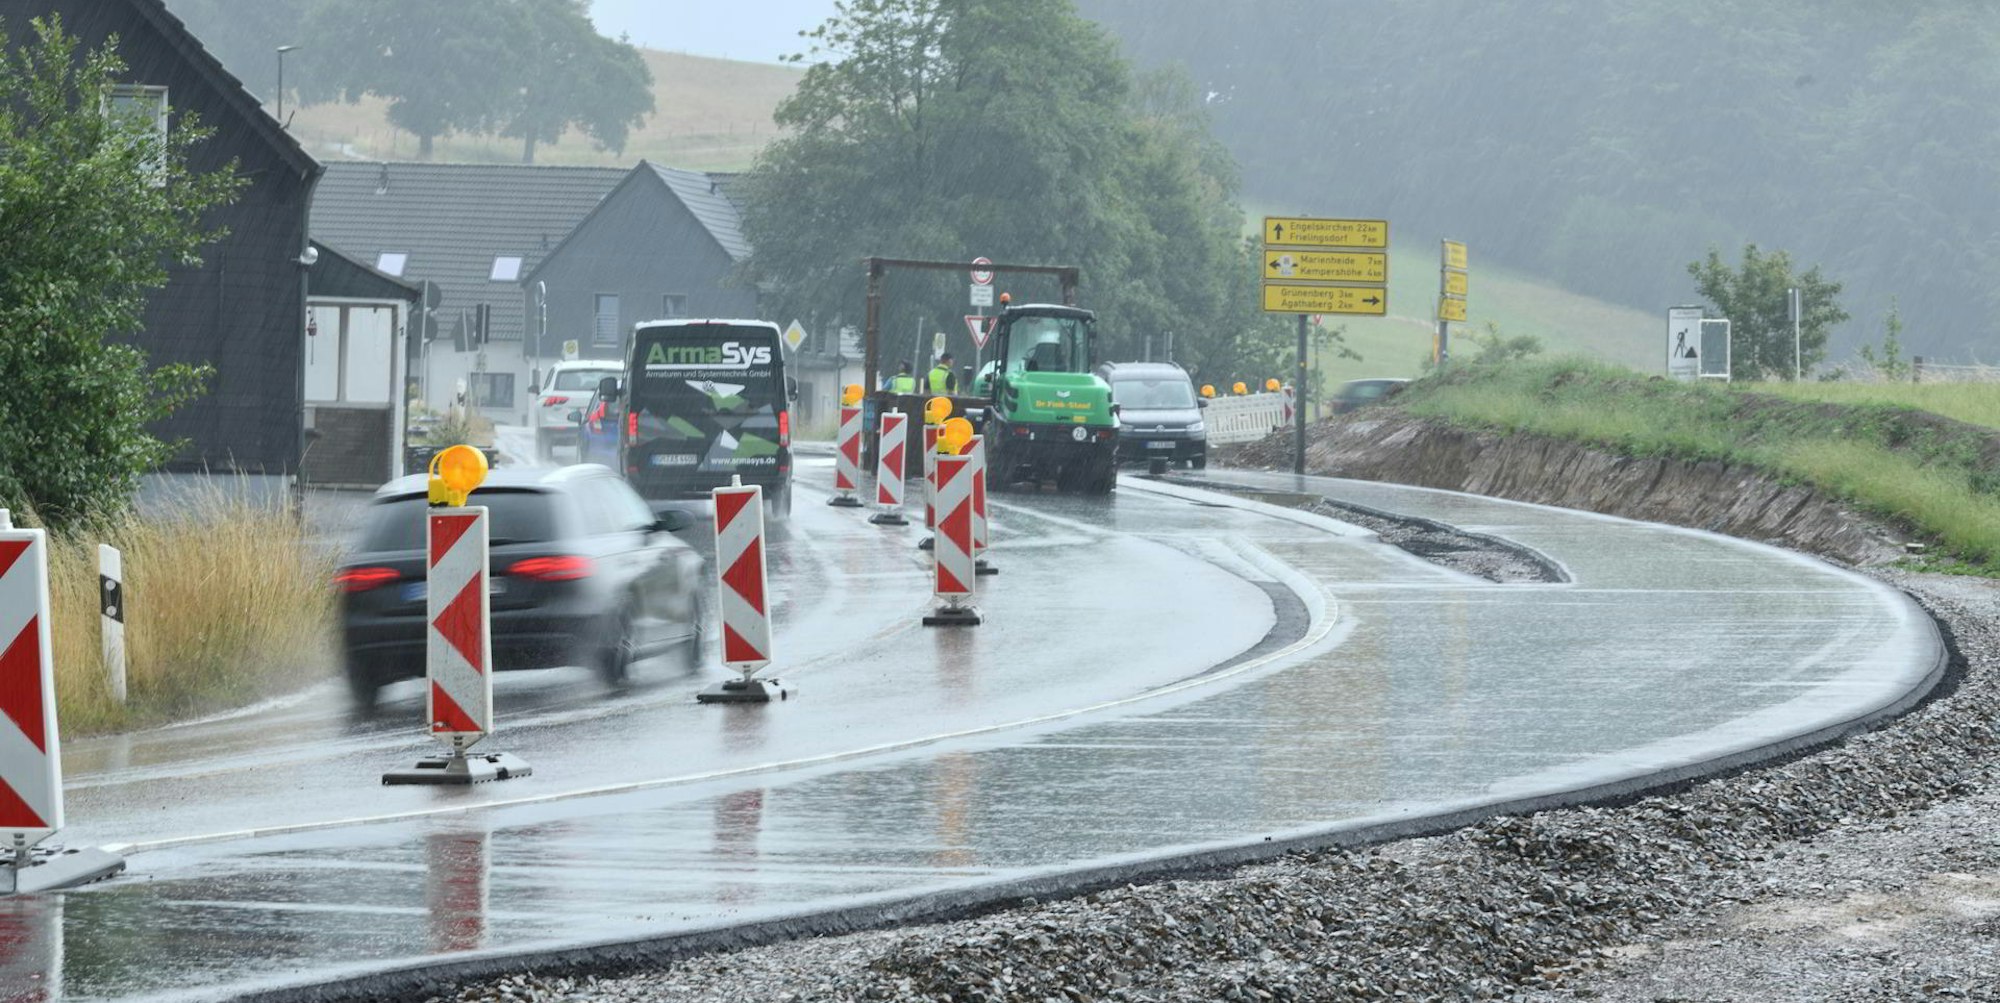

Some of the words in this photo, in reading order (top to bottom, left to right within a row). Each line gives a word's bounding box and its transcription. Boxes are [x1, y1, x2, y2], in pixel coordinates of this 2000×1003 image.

[1290, 222, 1353, 232] Engelskirchen
[1290, 232, 1348, 243] Frielingsdorf
[1301, 256, 1355, 265] Marienheide
[1301, 267, 1362, 278] Kempershöhe
[1281, 288, 1334, 299] Grünenberg
[1281, 299, 1333, 310] Agathaberg
[646, 341, 772, 368] ArmaSys
[646, 370, 682, 378] Armaturen
[683, 370, 697, 378] und
[698, 370, 747, 379] Systemtechnik
[711, 456, 776, 466] www.armasys.de
